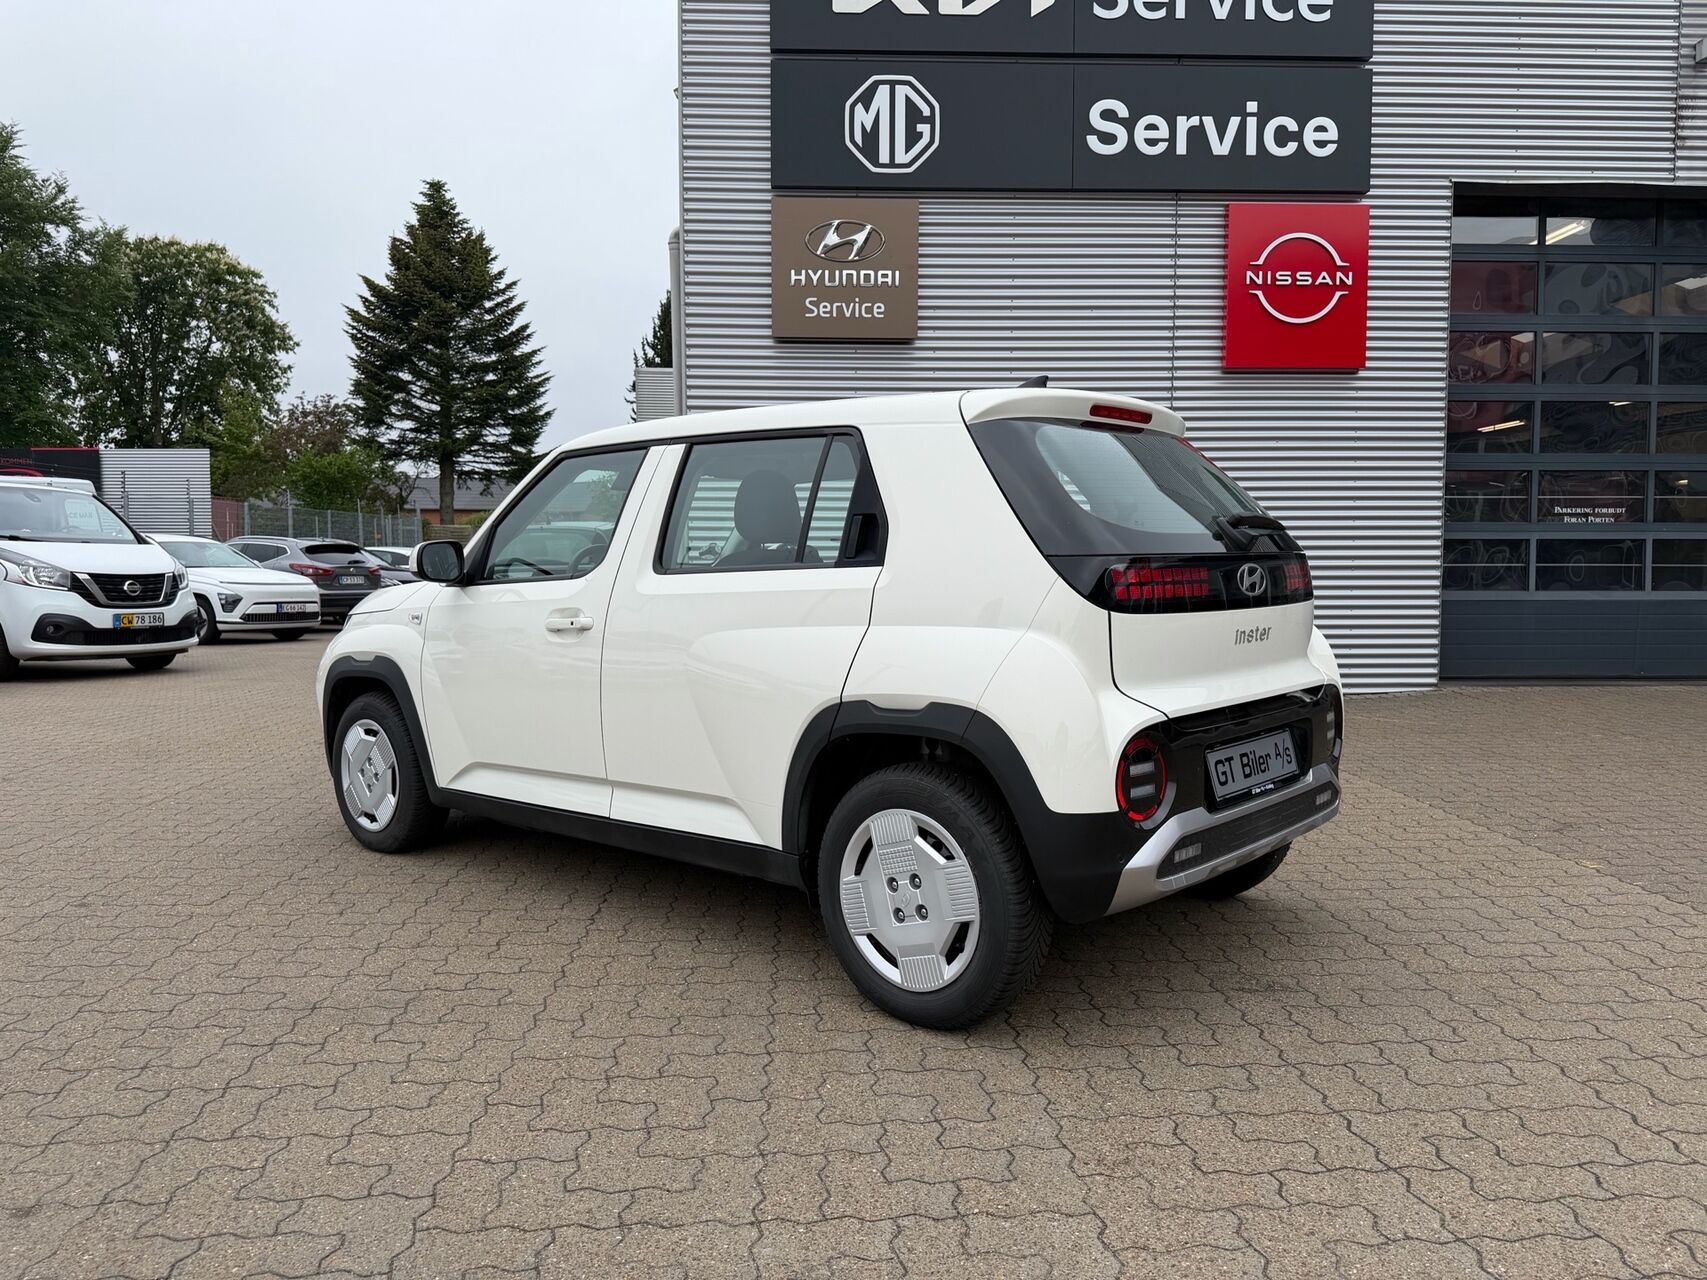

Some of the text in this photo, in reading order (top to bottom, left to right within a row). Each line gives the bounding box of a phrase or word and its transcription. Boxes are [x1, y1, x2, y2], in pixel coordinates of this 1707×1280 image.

[853, 84, 931, 164] MG
[1085, 98, 1339, 158] Service
[790, 269, 900, 287] HYUNDAI
[1245, 270, 1353, 286] NISSAN
[804, 297, 885, 318] Service
[121, 614, 163, 625] CW 78 186
[1214, 755, 1236, 787] GT
[1239, 749, 1272, 779] Biler
